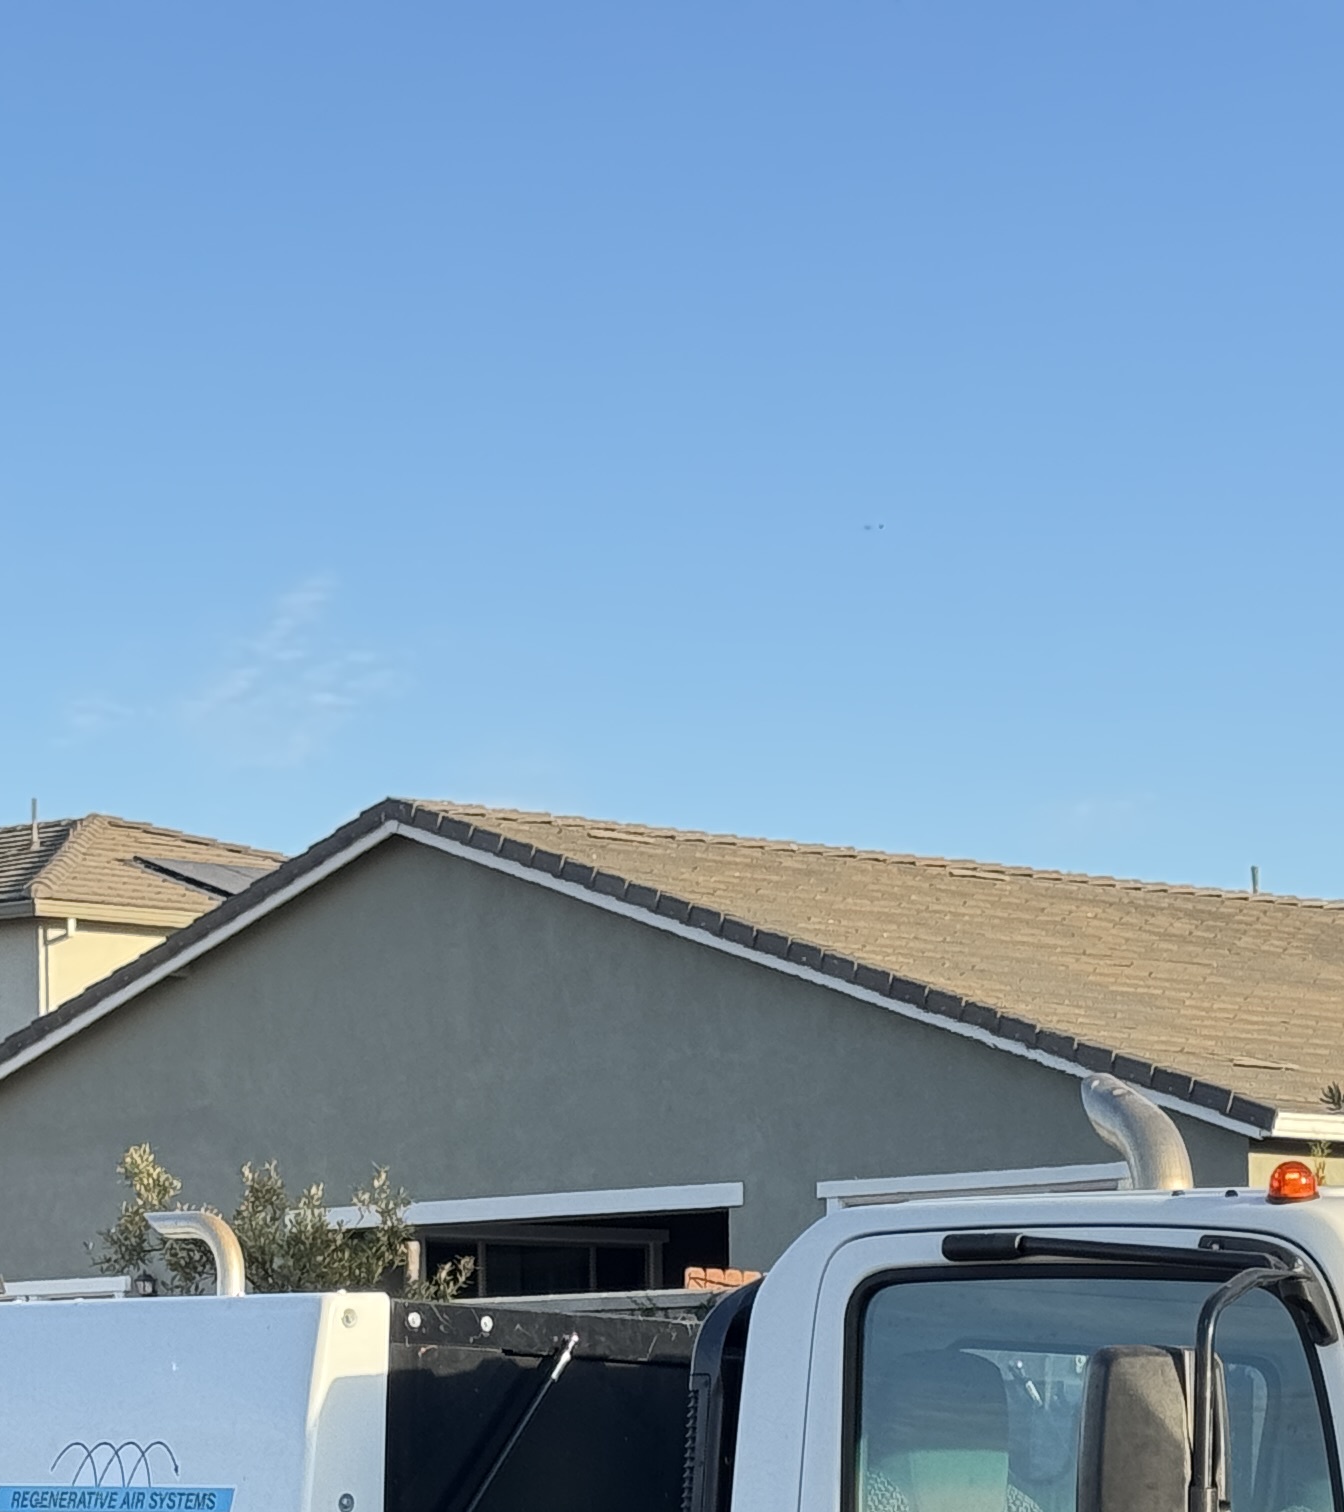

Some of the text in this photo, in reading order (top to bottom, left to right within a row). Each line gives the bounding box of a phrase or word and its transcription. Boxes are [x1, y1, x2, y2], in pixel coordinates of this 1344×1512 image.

[11, 1490, 217, 1511] REGENERATIVE AIR SYSTEMS
